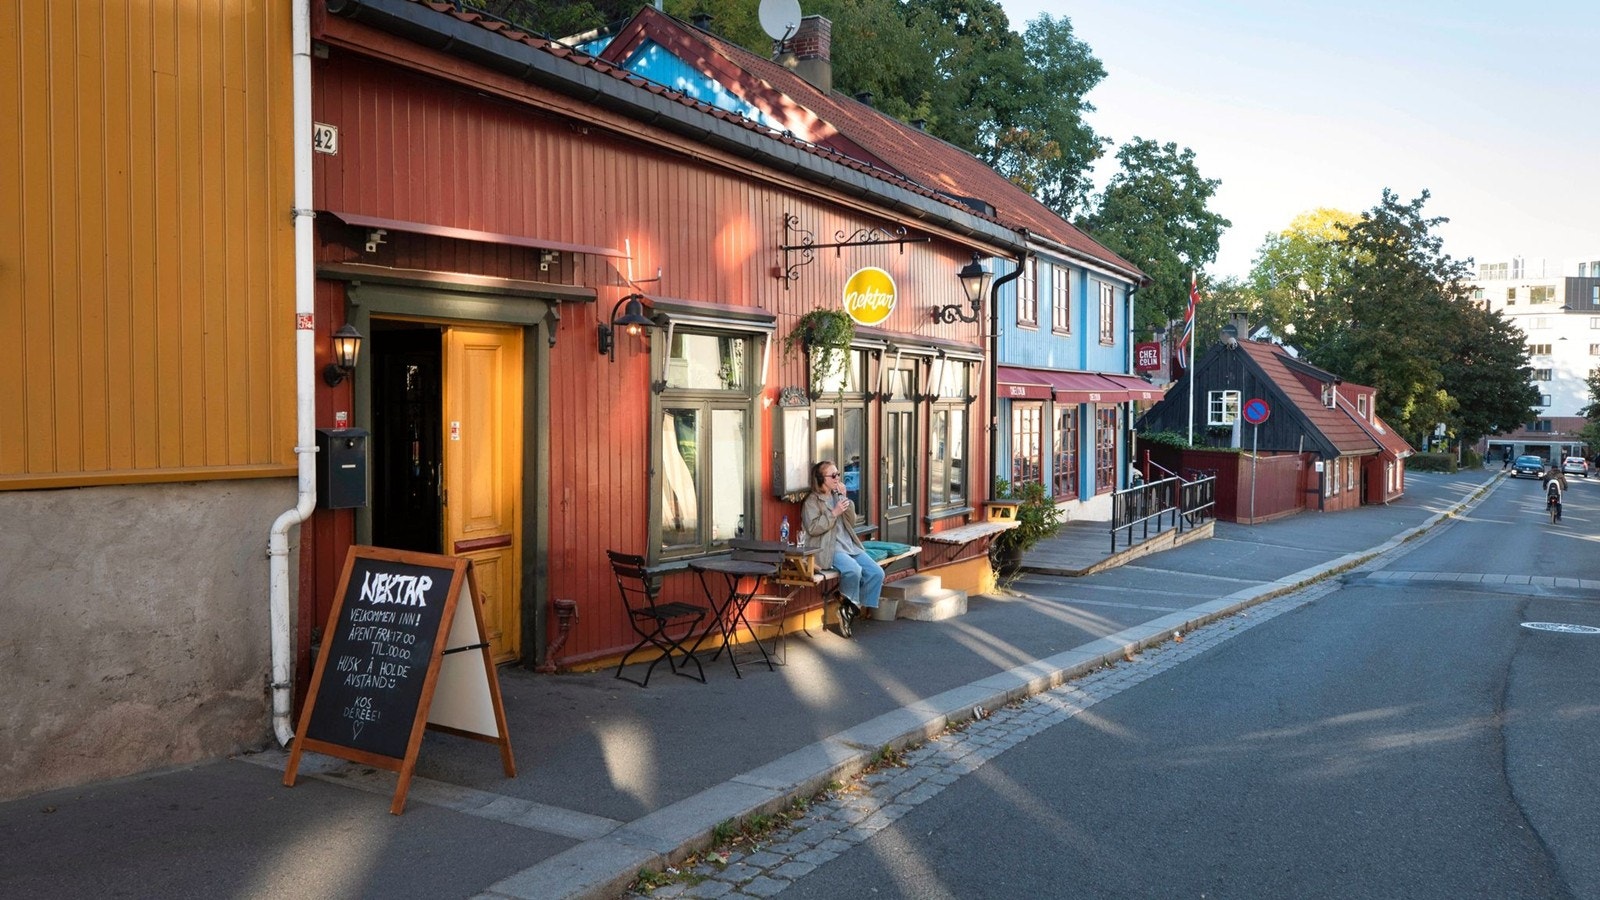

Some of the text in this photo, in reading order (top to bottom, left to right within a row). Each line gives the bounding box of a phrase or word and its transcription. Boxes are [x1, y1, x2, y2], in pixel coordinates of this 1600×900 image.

[314, 127, 332, 149] 42
[1139, 349, 1157, 358] CHEZ
[1139, 358, 1158, 366] COLIN
[359, 570, 433, 607] NEKTAR
[350, 608, 421, 627] VELKOMMEN INN!
[348, 624, 377, 641] ÅPENT
[337, 656, 411, 678] HUSK Å HOLDE
[344, 673, 387, 689] AVSTAND
[354, 696, 373, 709] KOS
